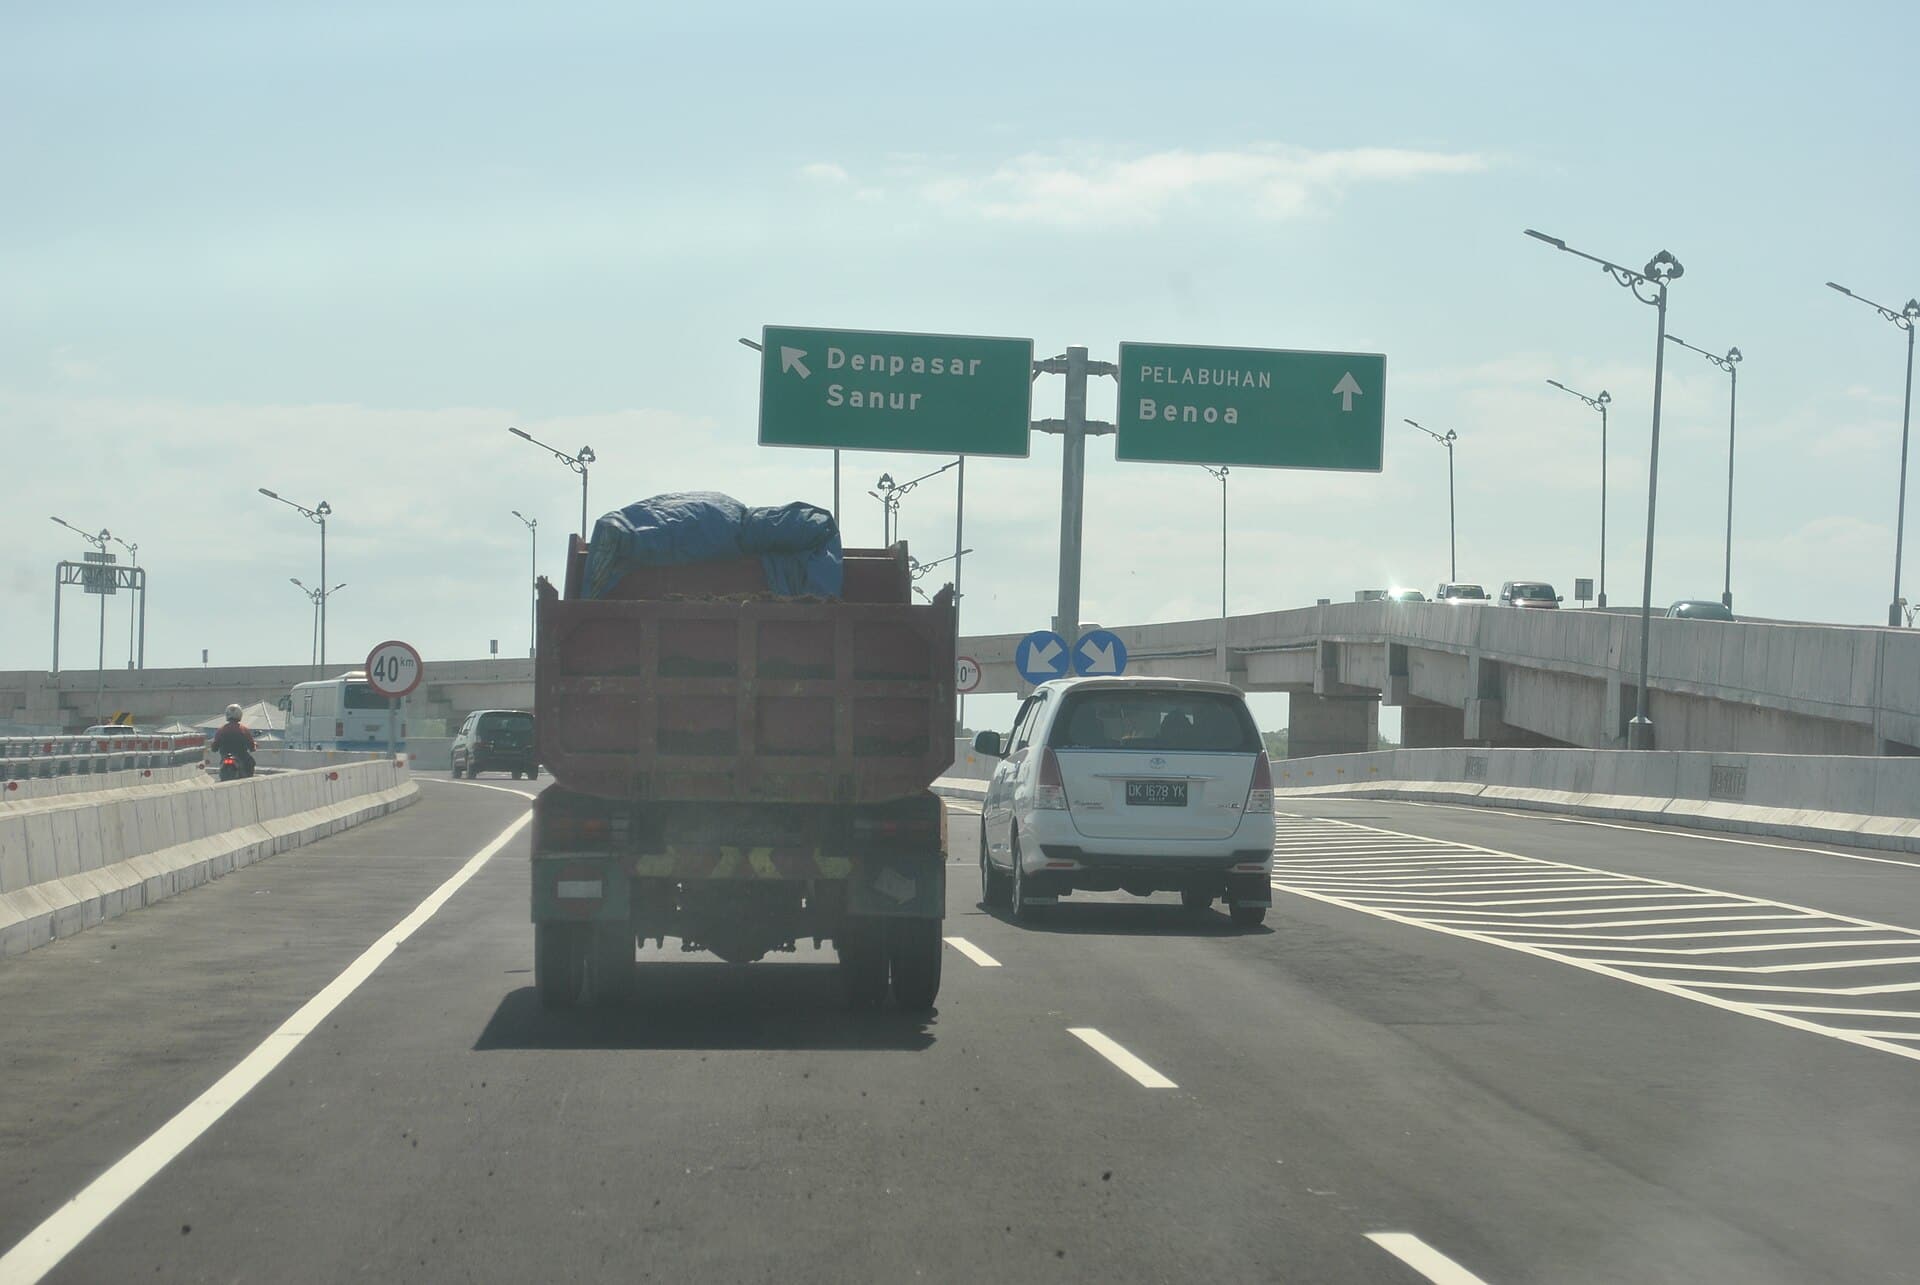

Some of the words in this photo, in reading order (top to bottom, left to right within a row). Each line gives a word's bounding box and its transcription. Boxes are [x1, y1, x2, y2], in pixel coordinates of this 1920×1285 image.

[827, 347, 981, 376] Denpasar
[1140, 365, 1271, 389] PELABUHAN
[826, 384, 922, 410] Sanur
[1139, 398, 1239, 424] Benoa
[373, 655, 398, 682] 40
[400, 656, 415, 667] km
[1128, 784, 1141, 797] DK
[1145, 784, 1169, 797] 1678
[1172, 784, 1185, 798] YK
